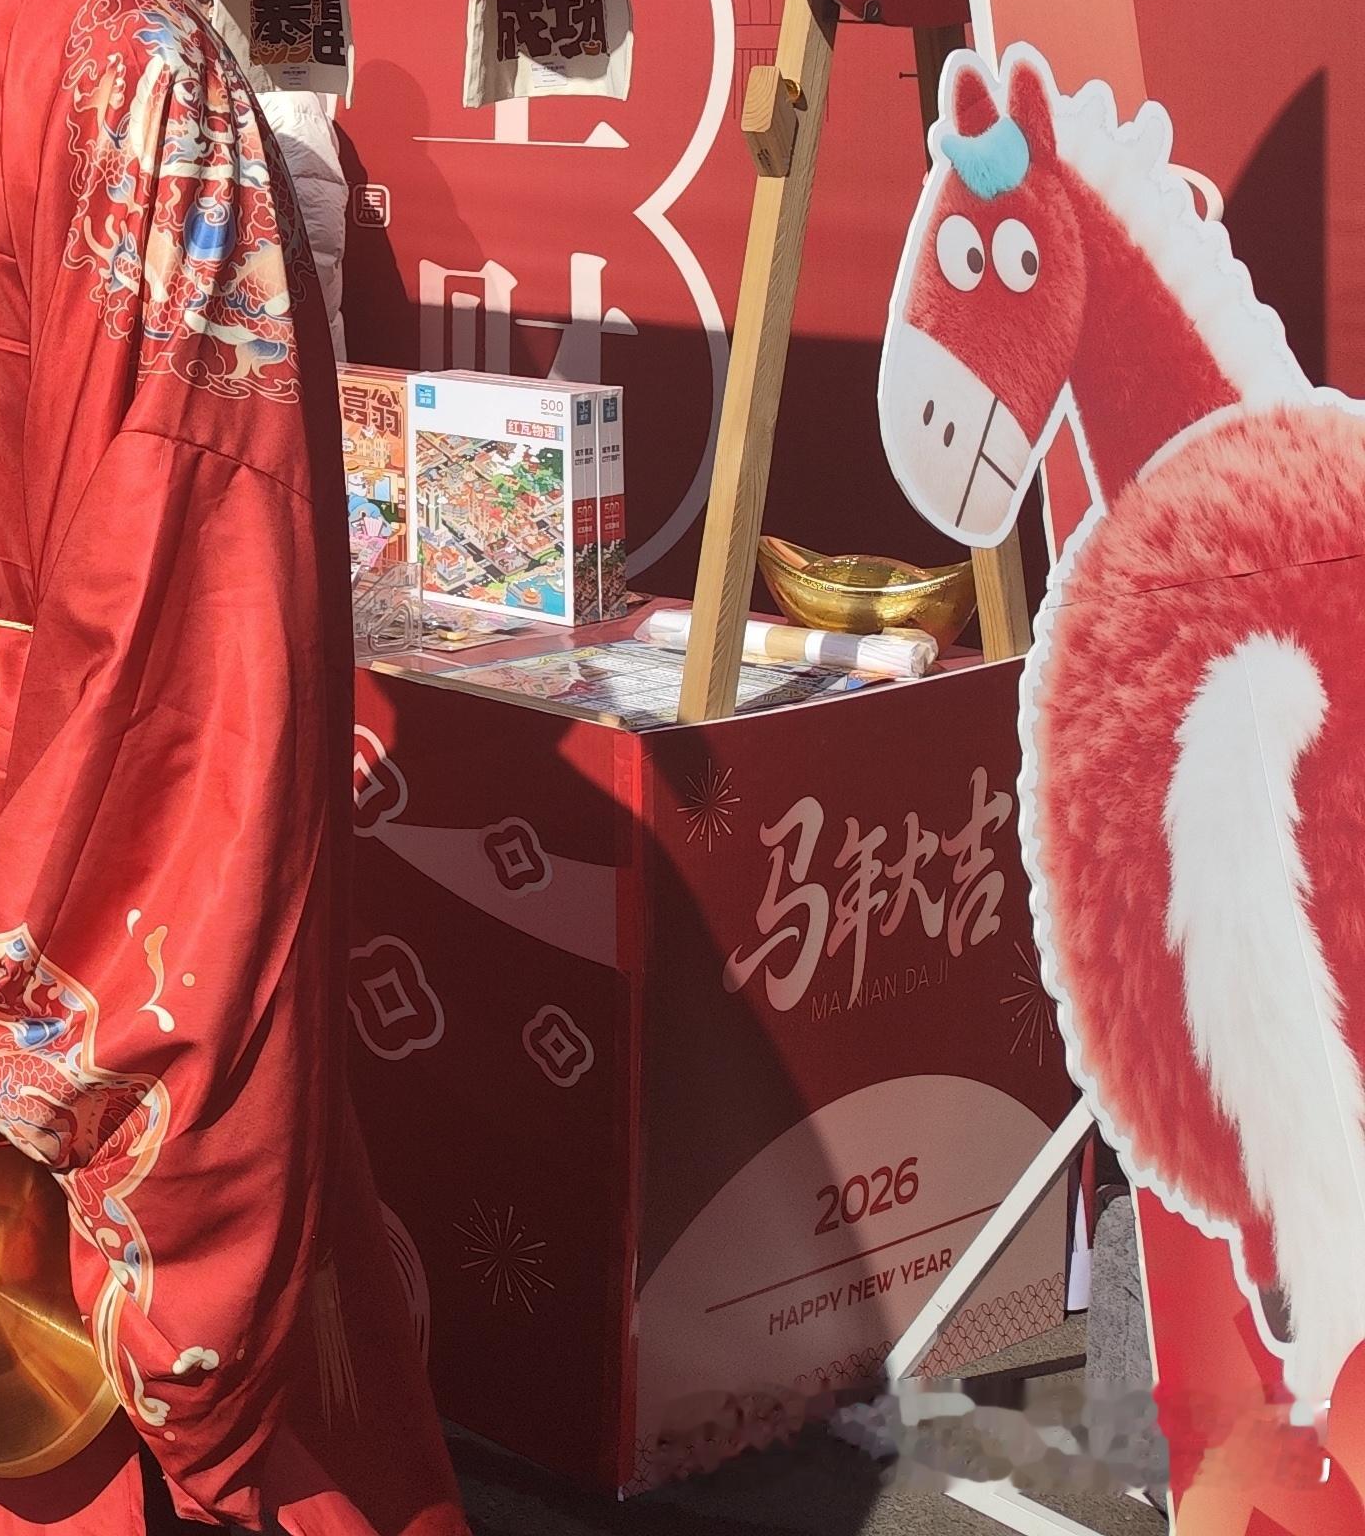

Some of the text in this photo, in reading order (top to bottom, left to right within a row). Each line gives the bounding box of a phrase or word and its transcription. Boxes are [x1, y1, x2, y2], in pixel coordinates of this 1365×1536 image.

[358, 191, 384, 221] 馬
[508, 421, 556, 439] 红瓦物语
[540, 398, 564, 412] 500
[722, 766, 1014, 1012] 马年大吉
[810, 958, 950, 1023] MA NIAN DA JI
[814, 1156, 919, 1236] 2026
[769, 1247, 953, 1336] HAPPY NEW YEAR
